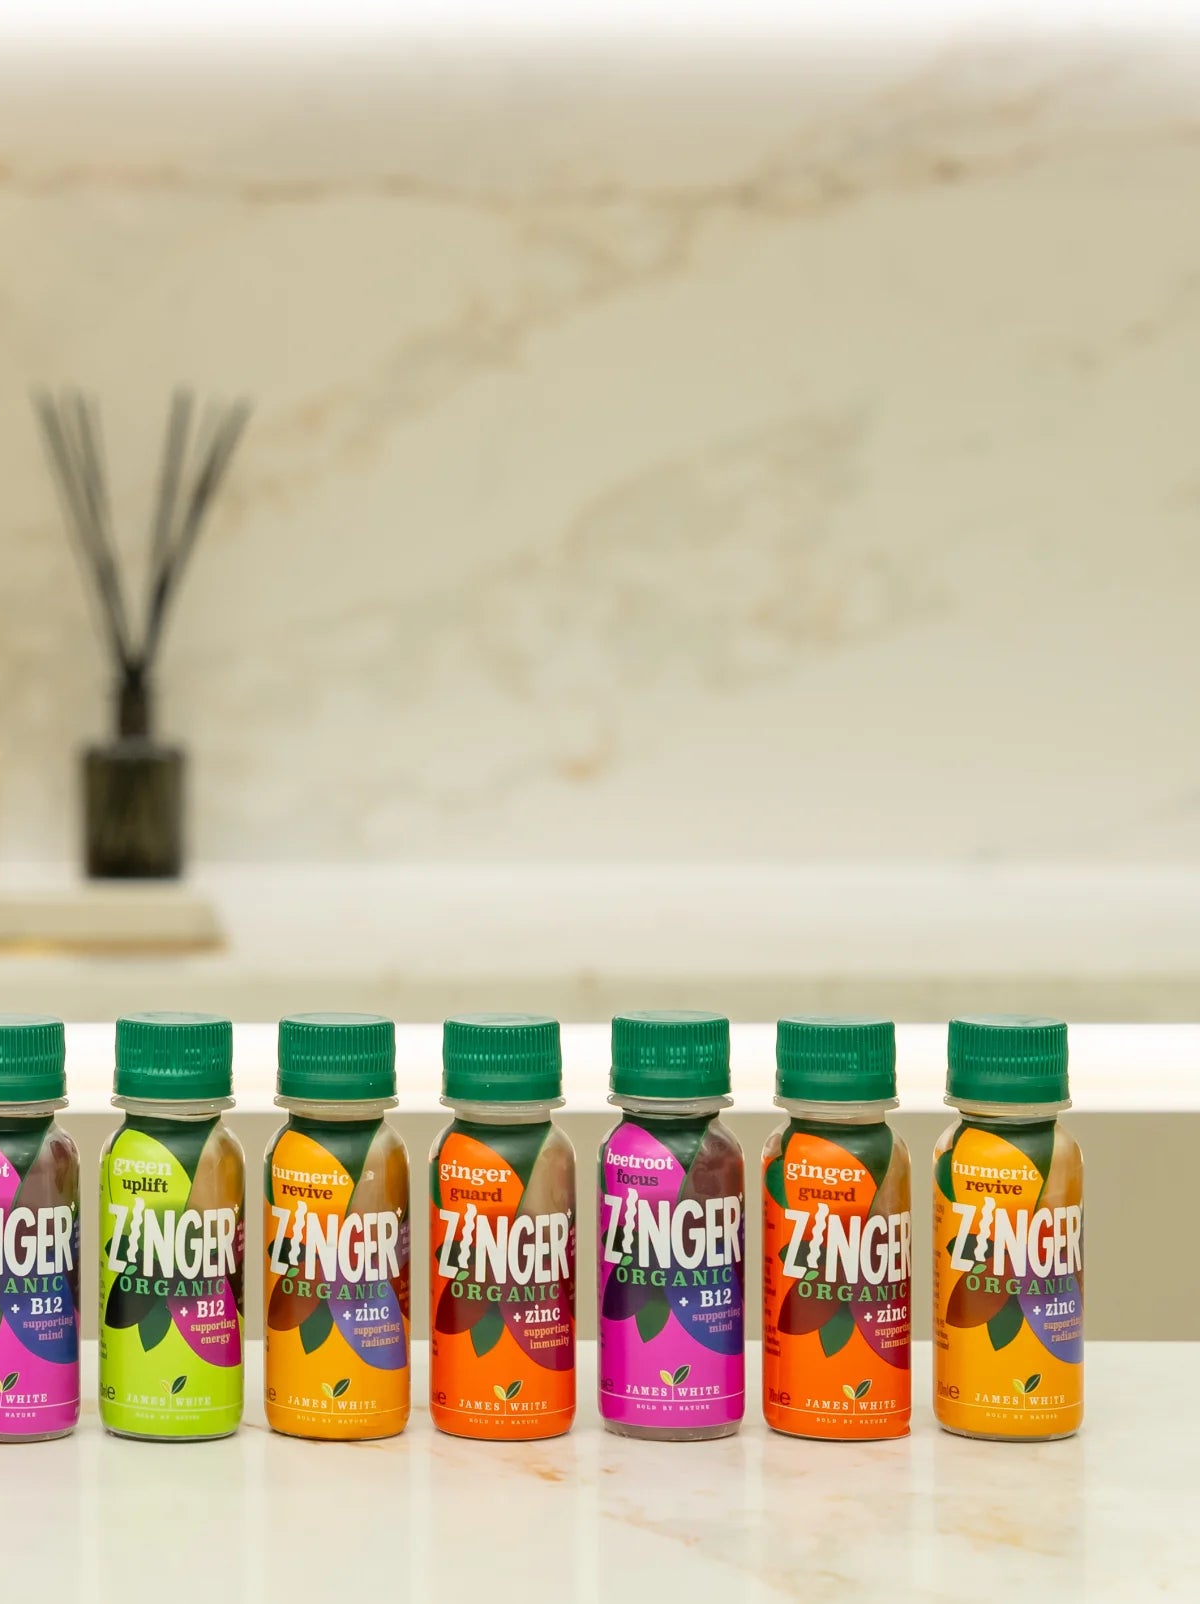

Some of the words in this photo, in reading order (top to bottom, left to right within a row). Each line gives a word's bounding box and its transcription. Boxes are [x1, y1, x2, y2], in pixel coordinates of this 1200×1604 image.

[113, 1157, 172, 1176] green
[606, 1148, 673, 1170] beetroot
[272, 1164, 350, 1187] turmeric
[440, 1161, 512, 1185] ginger
[616, 1169, 659, 1186] focus
[786, 1159, 866, 1185] ginger
[953, 1160, 1038, 1181] turmeric
[122, 1178, 168, 1194] uplift
[281, 1184, 333, 1199] revive
[450, 1186, 502, 1202] guard
[798, 1187, 855, 1202] guard
[966, 1180, 1022, 1196] revive
[108, 1197, 236, 1279] ZINGER
[603, 1188, 741, 1269] ZINGER
[950, 1196, 1082, 1278] ZINGER
[270, 1201, 400, 1283] ZINGER
[438, 1203, 569, 1284] ZINGER
[782, 1202, 911, 1285] ZINGER
[120, 1276, 225, 1297] ORGANIC
[616, 1267, 732, 1288] ORGANIC
[966, 1274, 1075, 1295] ORGANIC
[281, 1280, 388, 1300] ORGANIC
[451, 1281, 559, 1302] ORGANIC
[700, 1288, 731, 1307] B12
[799, 1280, 907, 1301] ORGANIC
[30, 1297, 63, 1315] B12
[197, 1300, 225, 1318] B12
[355, 1303, 389, 1322] zinc
[525, 1303, 560, 1323] zinc
[877, 1303, 907, 1323] zinc
[1045, 1297, 1075, 1316] zinc
[6, 1393, 47, 1403] WHITE
[626, 1385, 667, 1396] JAMES
[678, 1385, 720, 1395] WHITE
[975, 1393, 1019, 1405] JAMES
[1029, 1394, 1065, 1405] WHITE
[287, 1396, 327, 1409] JAMES
[338, 1399, 376, 1410] WHITE
[459, 1400, 500, 1411] JAMES
[510, 1401, 547, 1410] WHITE
[806, 1398, 849, 1410] JAMES
[859, 1399, 896, 1410] WHITE
